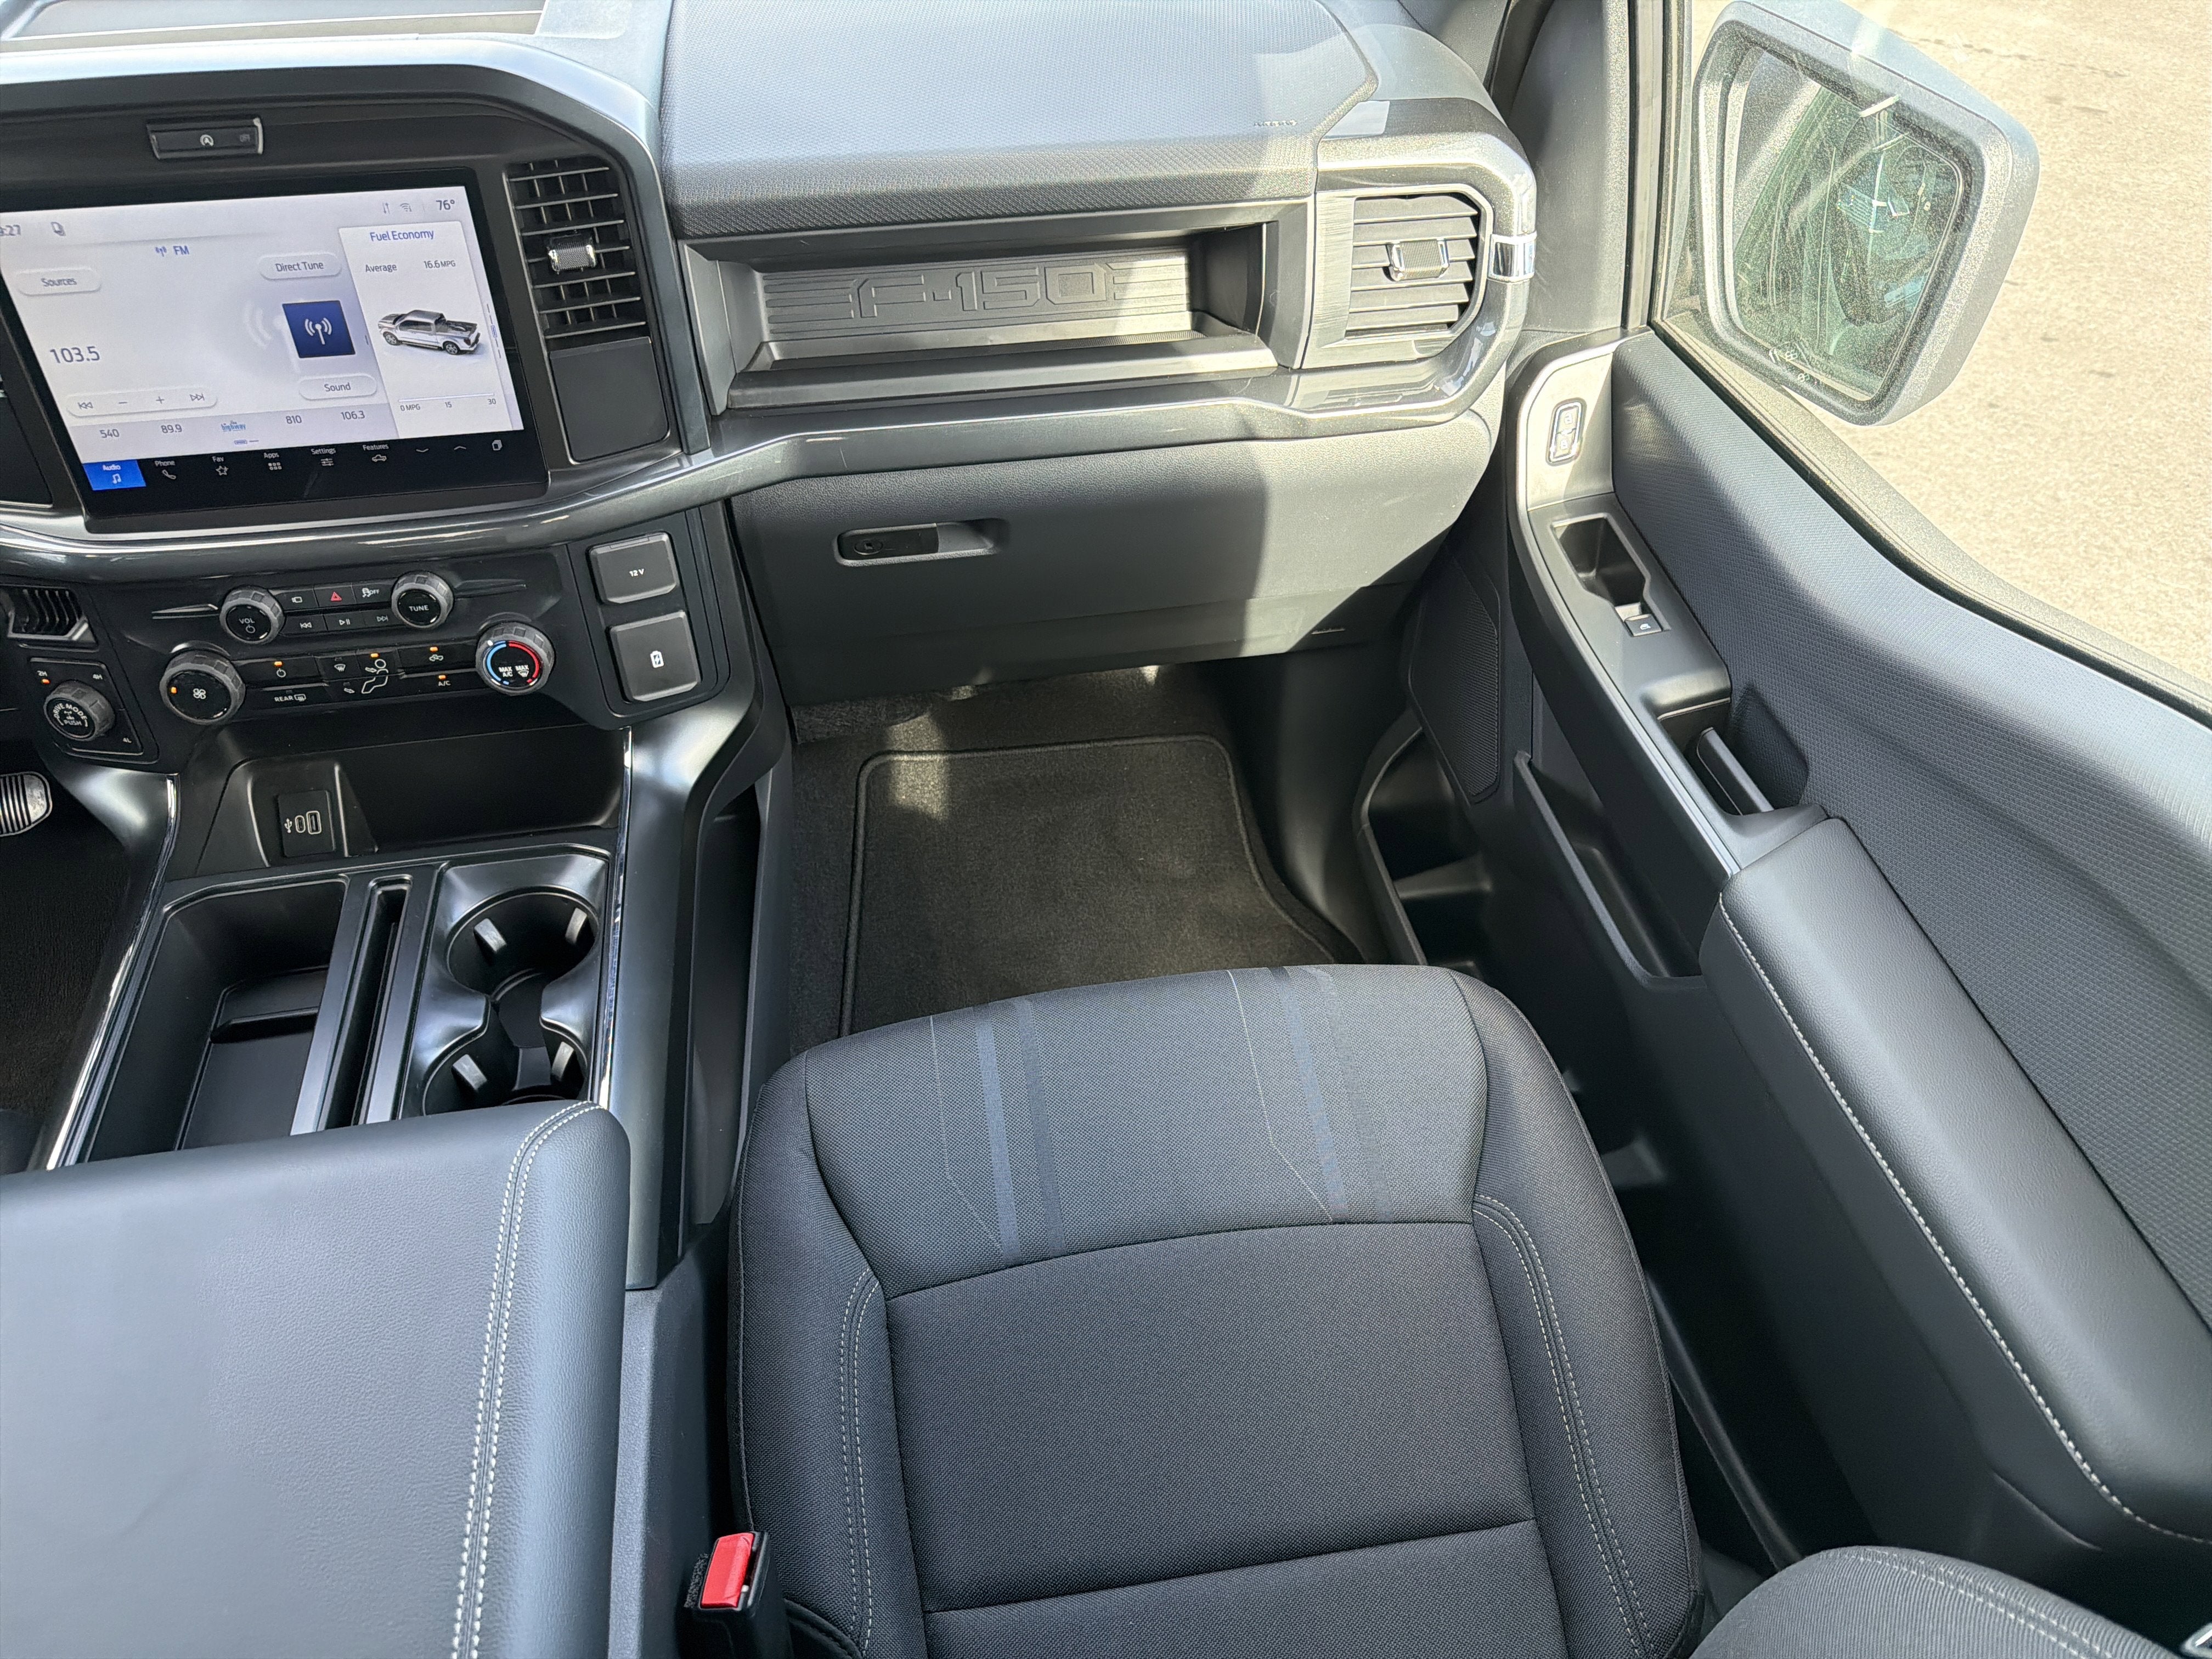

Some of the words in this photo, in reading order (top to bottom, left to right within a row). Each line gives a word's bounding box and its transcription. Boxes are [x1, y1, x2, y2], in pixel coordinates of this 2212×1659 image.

[369, 231, 391, 242] Fuel
[392, 229, 434, 240] Economy
[173, 245, 190, 255] FM
[275, 261, 301, 272] Direct
[301, 261, 324, 270] Tune
[365, 263, 397, 273] Average
[41, 278, 77, 287] Sources
[857, 262, 1107, 318] F-150
[50, 346, 100, 364] 103.5
[324, 382, 351, 392] Sound
[285, 415, 302, 425] 810
[341, 410, 365, 420] 106.3
[100, 428, 120, 438] 540
[161, 424, 182, 433] 89.9
[53, 703, 65, 719] DRIVE
[65, 703, 88, 720] MODE
